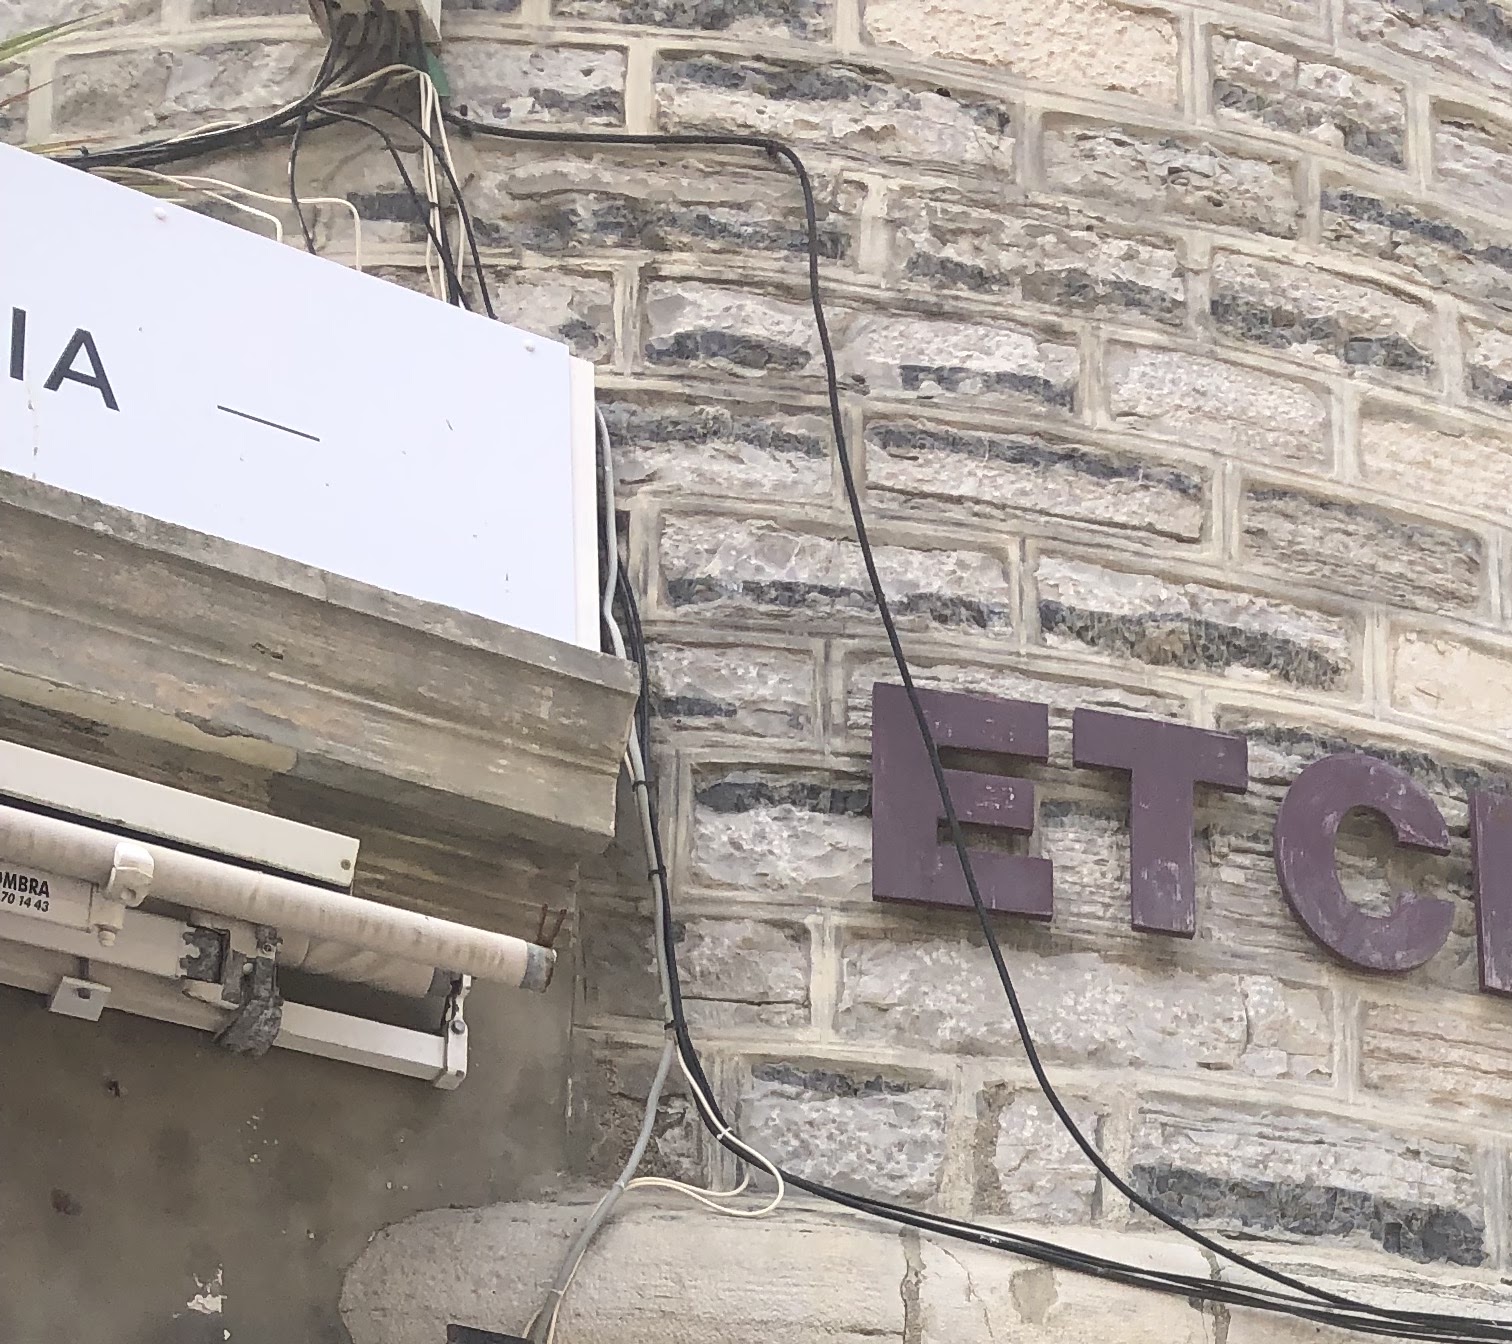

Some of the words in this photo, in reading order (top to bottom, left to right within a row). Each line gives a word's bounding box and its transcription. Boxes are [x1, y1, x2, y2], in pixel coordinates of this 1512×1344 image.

[9, 306, 121, 412] IA
[0, 871, 50, 899] MBRA
[19, 895, 32, 909] 14
[33, 899, 50, 913] 43
